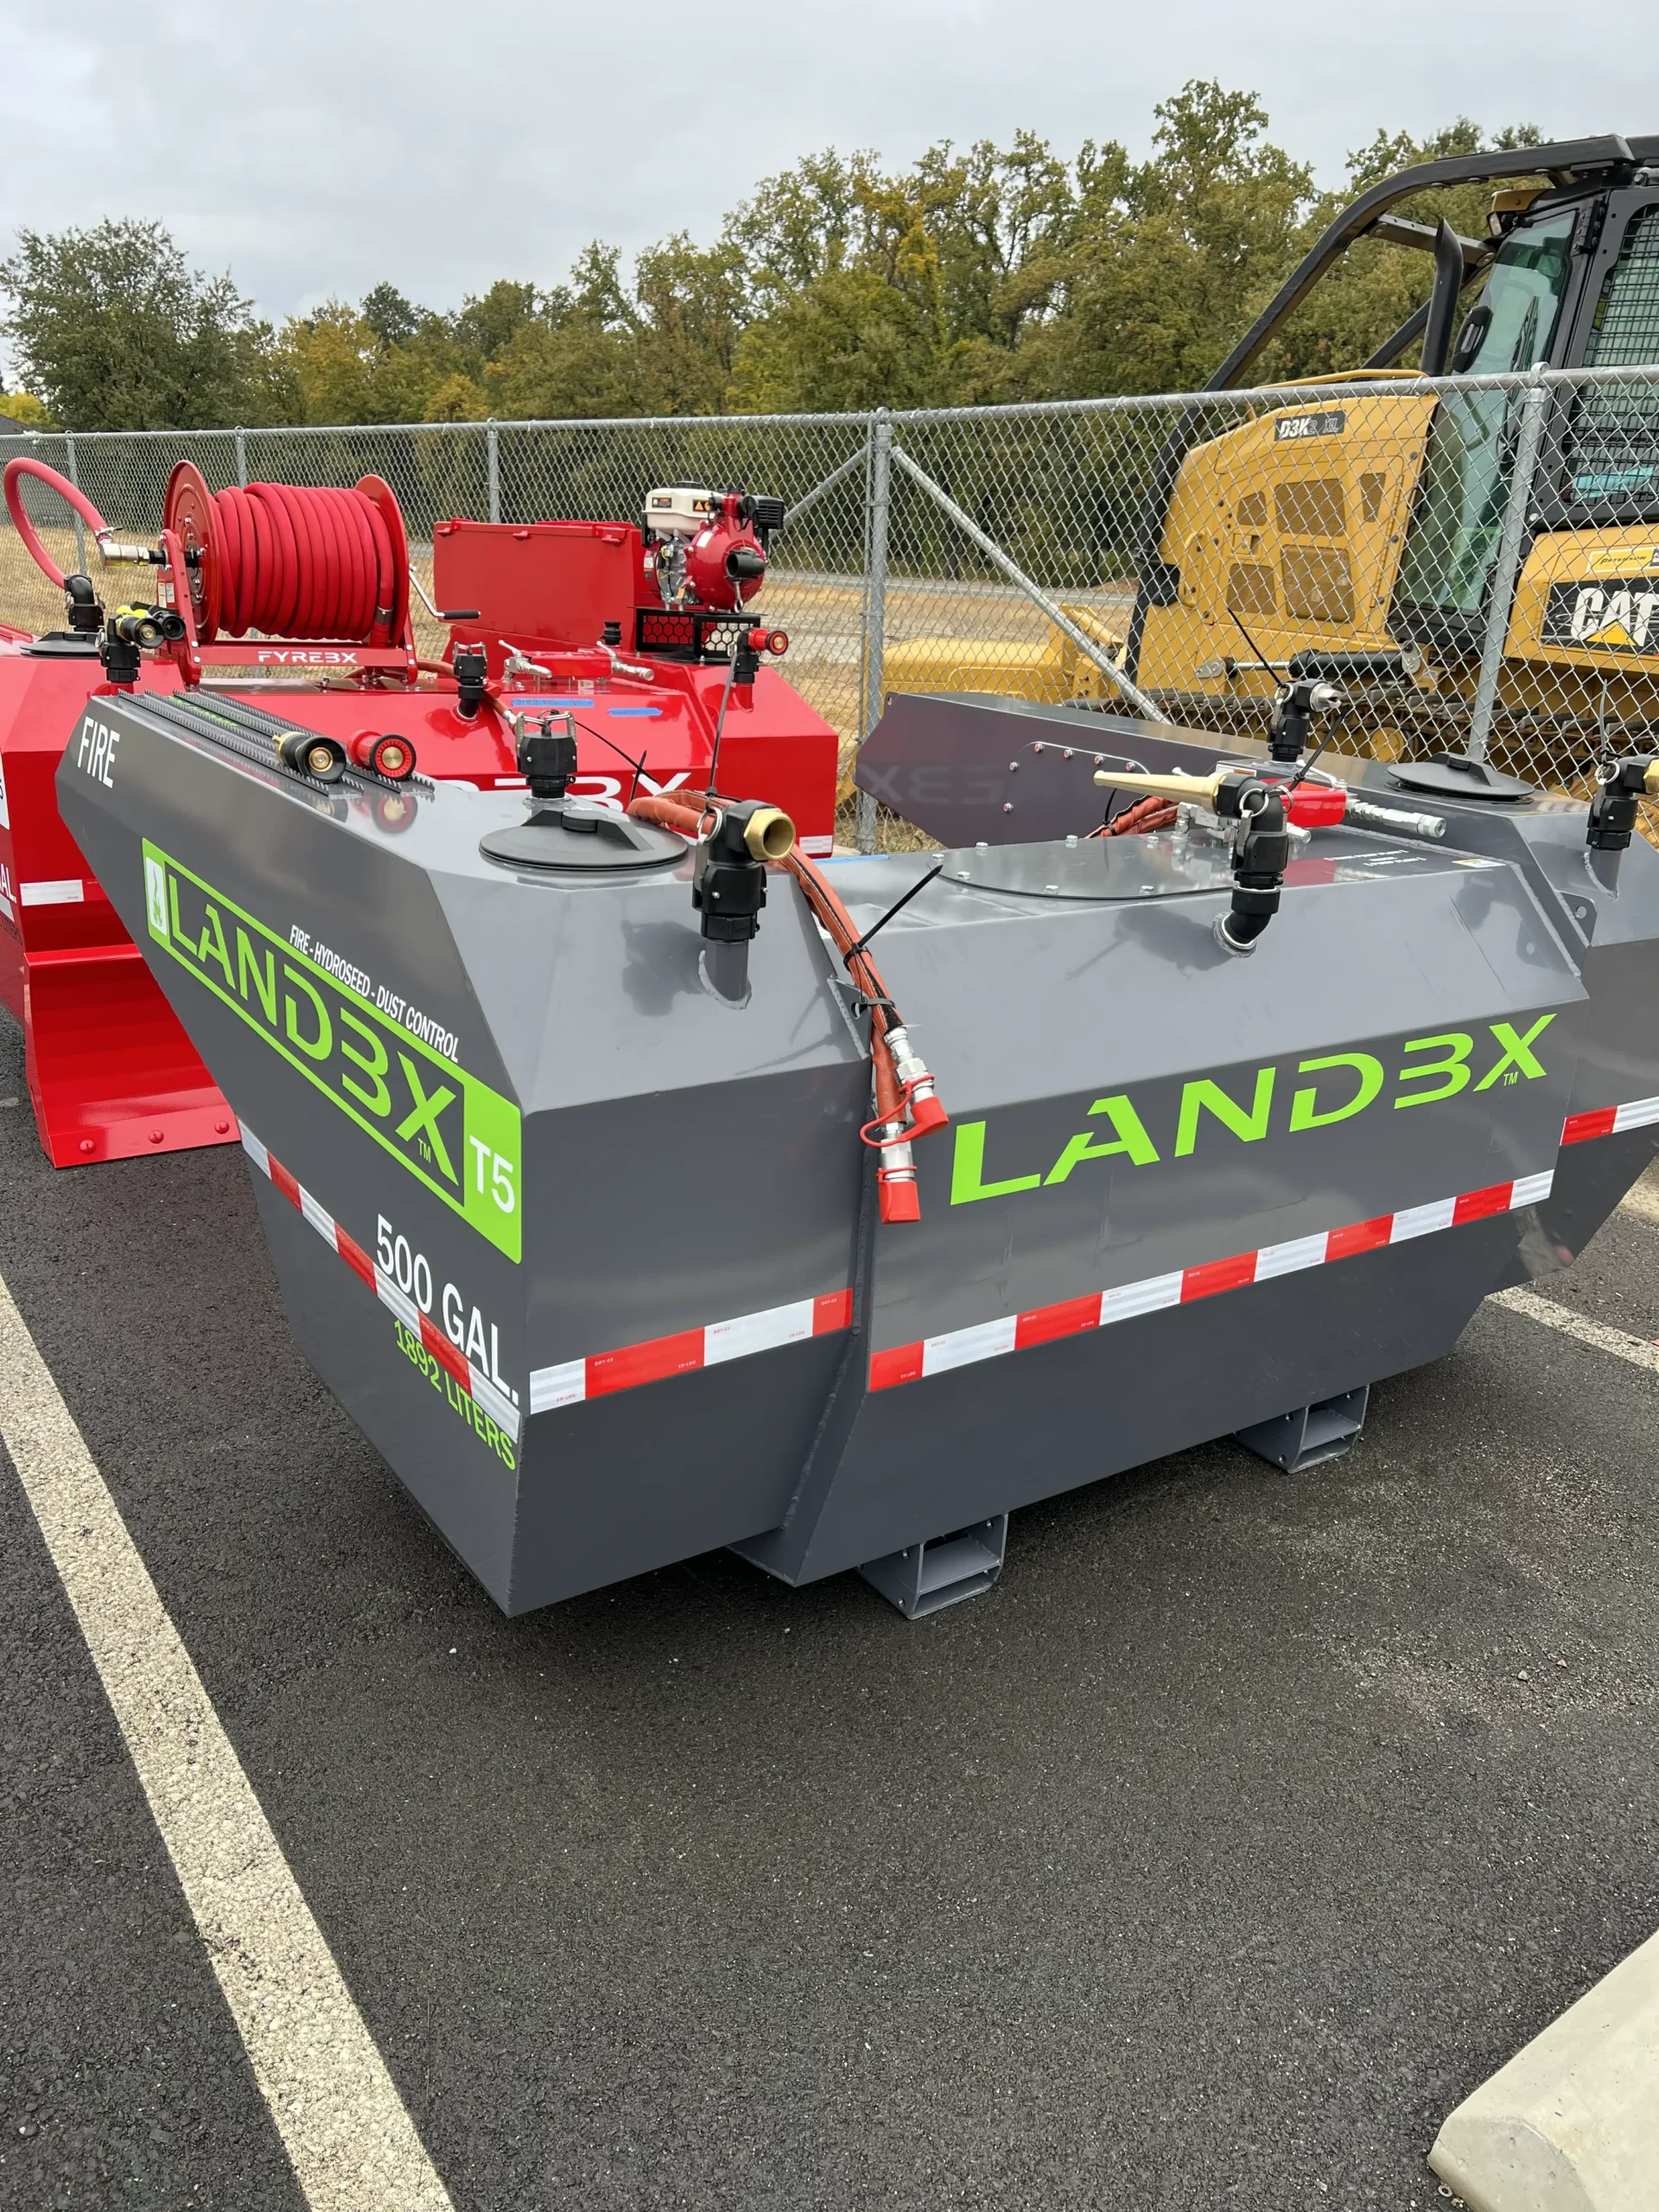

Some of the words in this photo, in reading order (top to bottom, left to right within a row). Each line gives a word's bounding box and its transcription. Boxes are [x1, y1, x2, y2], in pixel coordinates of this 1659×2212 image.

[1570, 588, 1659, 646] CAT
[76, 716, 122, 789] FIRE
[289, 924, 310, 956] FIRE
[314, 941, 371, 998] HYDROSEED
[376, 985, 407, 1023] DUST
[405, 1006, 459, 1064] CONTROL
[1503, 1071, 1519, 1087] TM
[417, 1137, 431, 1163] TM
[469, 1135, 516, 1214] T5
[377, 1212, 433, 1314] 500
[442, 1282, 518, 1406] GAL.
[394, 1319, 442, 1394] 1892
[444, 1370, 515, 1470] LITERS
